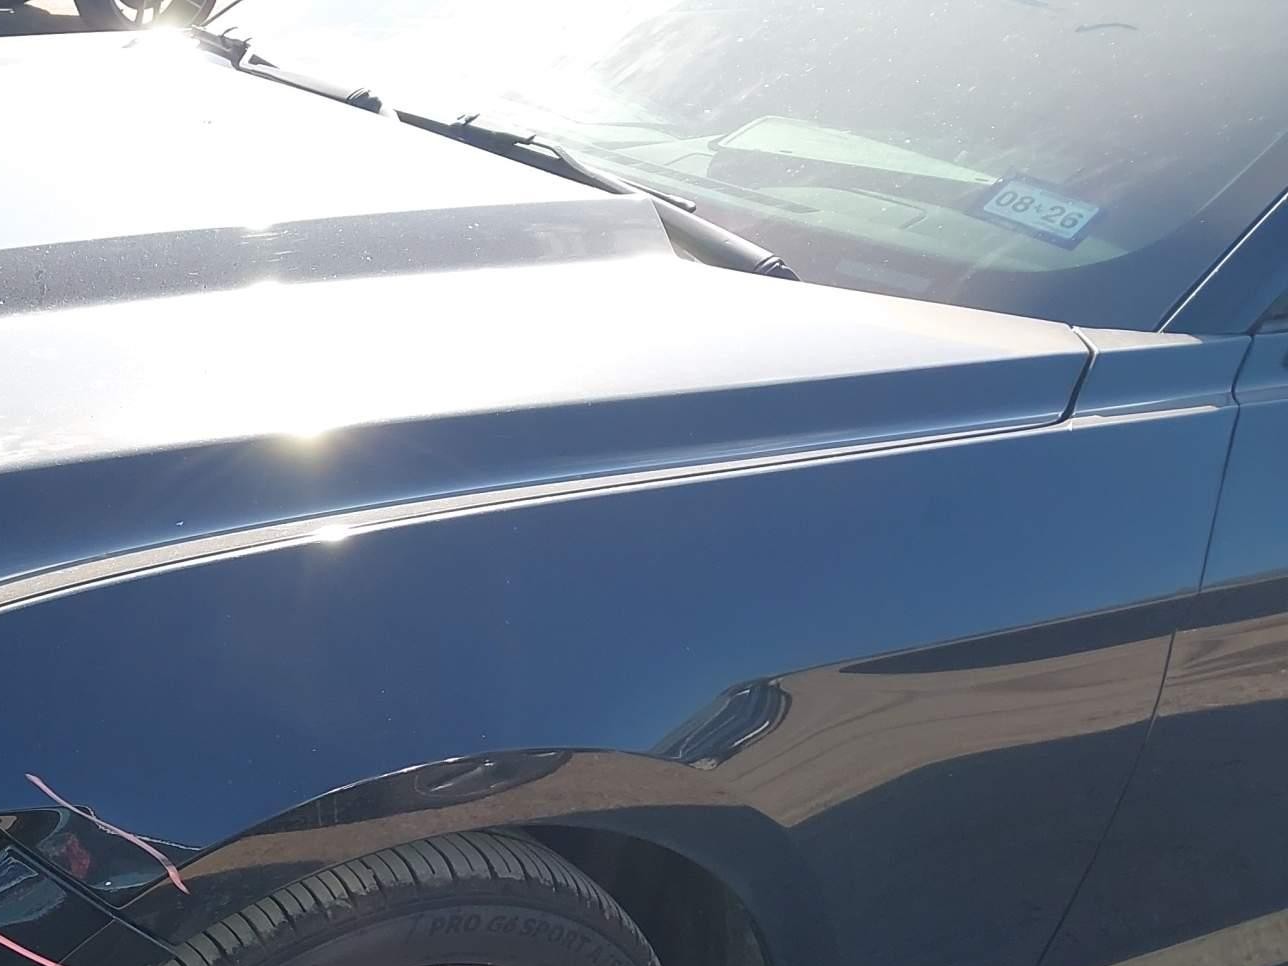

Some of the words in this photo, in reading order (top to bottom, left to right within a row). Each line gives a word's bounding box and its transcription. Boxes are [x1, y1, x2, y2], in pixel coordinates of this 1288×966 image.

[995, 191, 1035, 213] 08
[1040, 205, 1084, 229] 26
[428, 914, 481, 937] PRO
[486, 914, 520, 934] G6
[519, 917, 592, 952] SPORT
